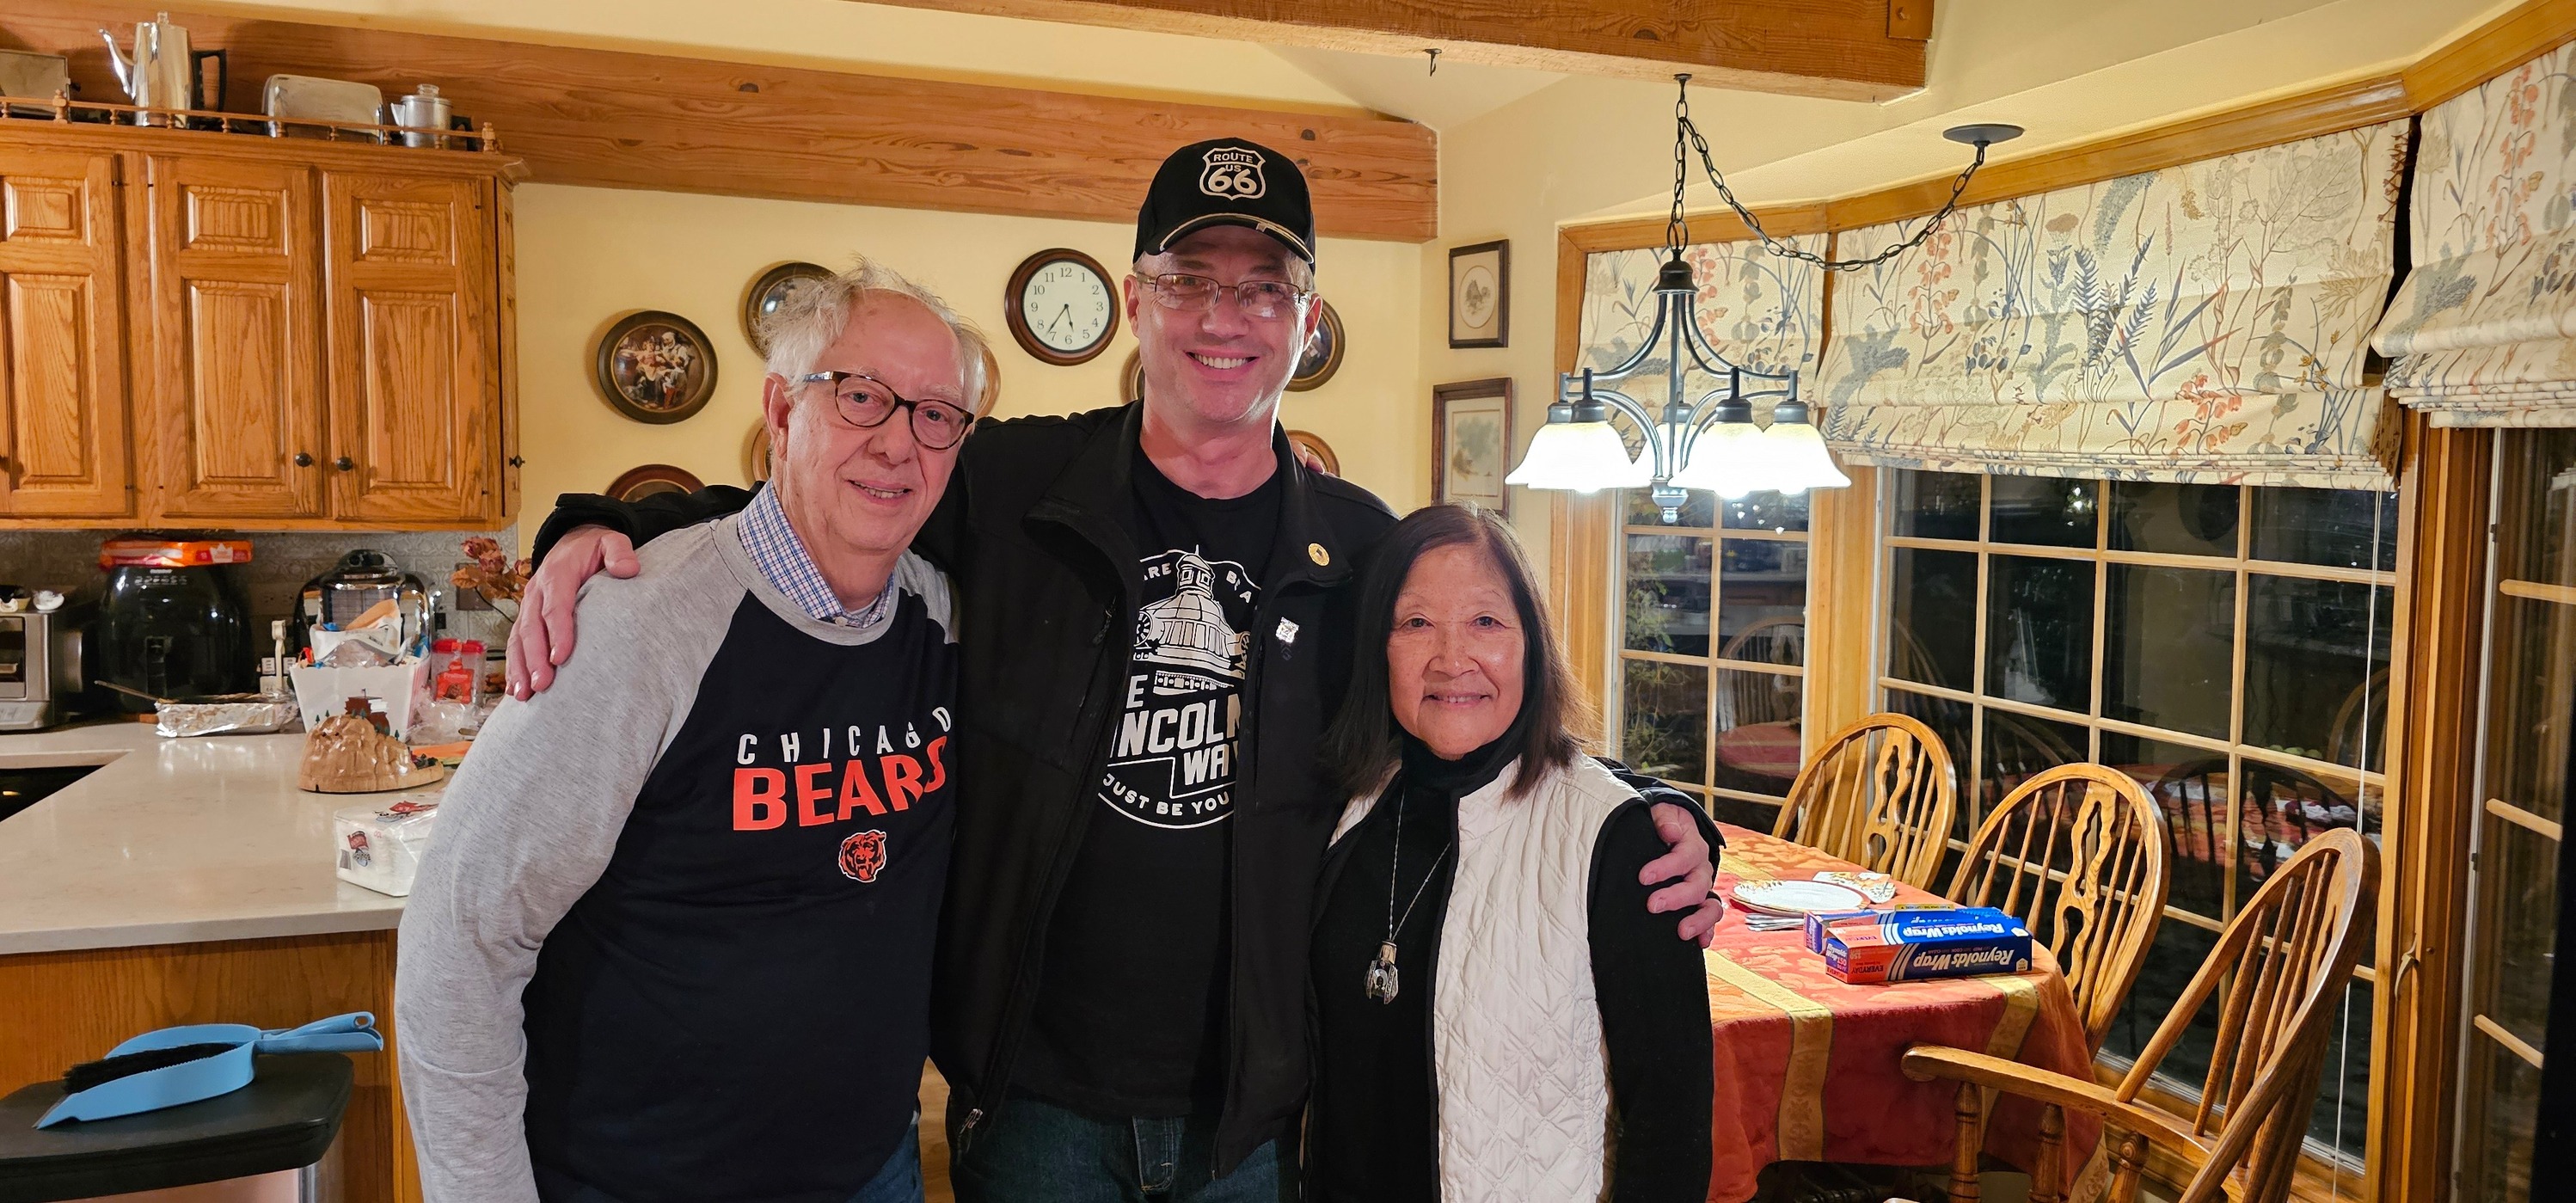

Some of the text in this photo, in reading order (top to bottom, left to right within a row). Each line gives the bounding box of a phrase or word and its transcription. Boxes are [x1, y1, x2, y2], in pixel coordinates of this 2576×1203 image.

[1213, 152, 1253, 163] ROUTE
[1208, 167, 1257, 194] 66
[1060, 267, 1072, 277] 12
[1046, 273, 1054, 282] 11
[1082, 273, 1085, 282] 1
[1033, 285, 1046, 295] 10
[1092, 285, 1099, 295] 2
[1031, 303, 1039, 312] 9
[1096, 302, 1103, 311] 3
[1037, 320, 1045, 329] 8
[1092, 318, 1099, 327] 4
[1050, 331, 1057, 341] 7
[1083, 329, 1090, 339] 5
[1065, 335, 1072, 344] 6
[1144, 563, 1172, 581] RE
[737, 706, 952, 764] CHICAGO
[733, 735, 948, 831] BEARS
[1102, 773, 1230, 816] JUST BE YOU
[1903, 923, 2005, 938] Reynolds Wrap
[1913, 951, 1952, 971] Wrap
[1951, 947, 2015, 967] Reynolds
[1851, 965, 1884, 974] EVERYDAY
